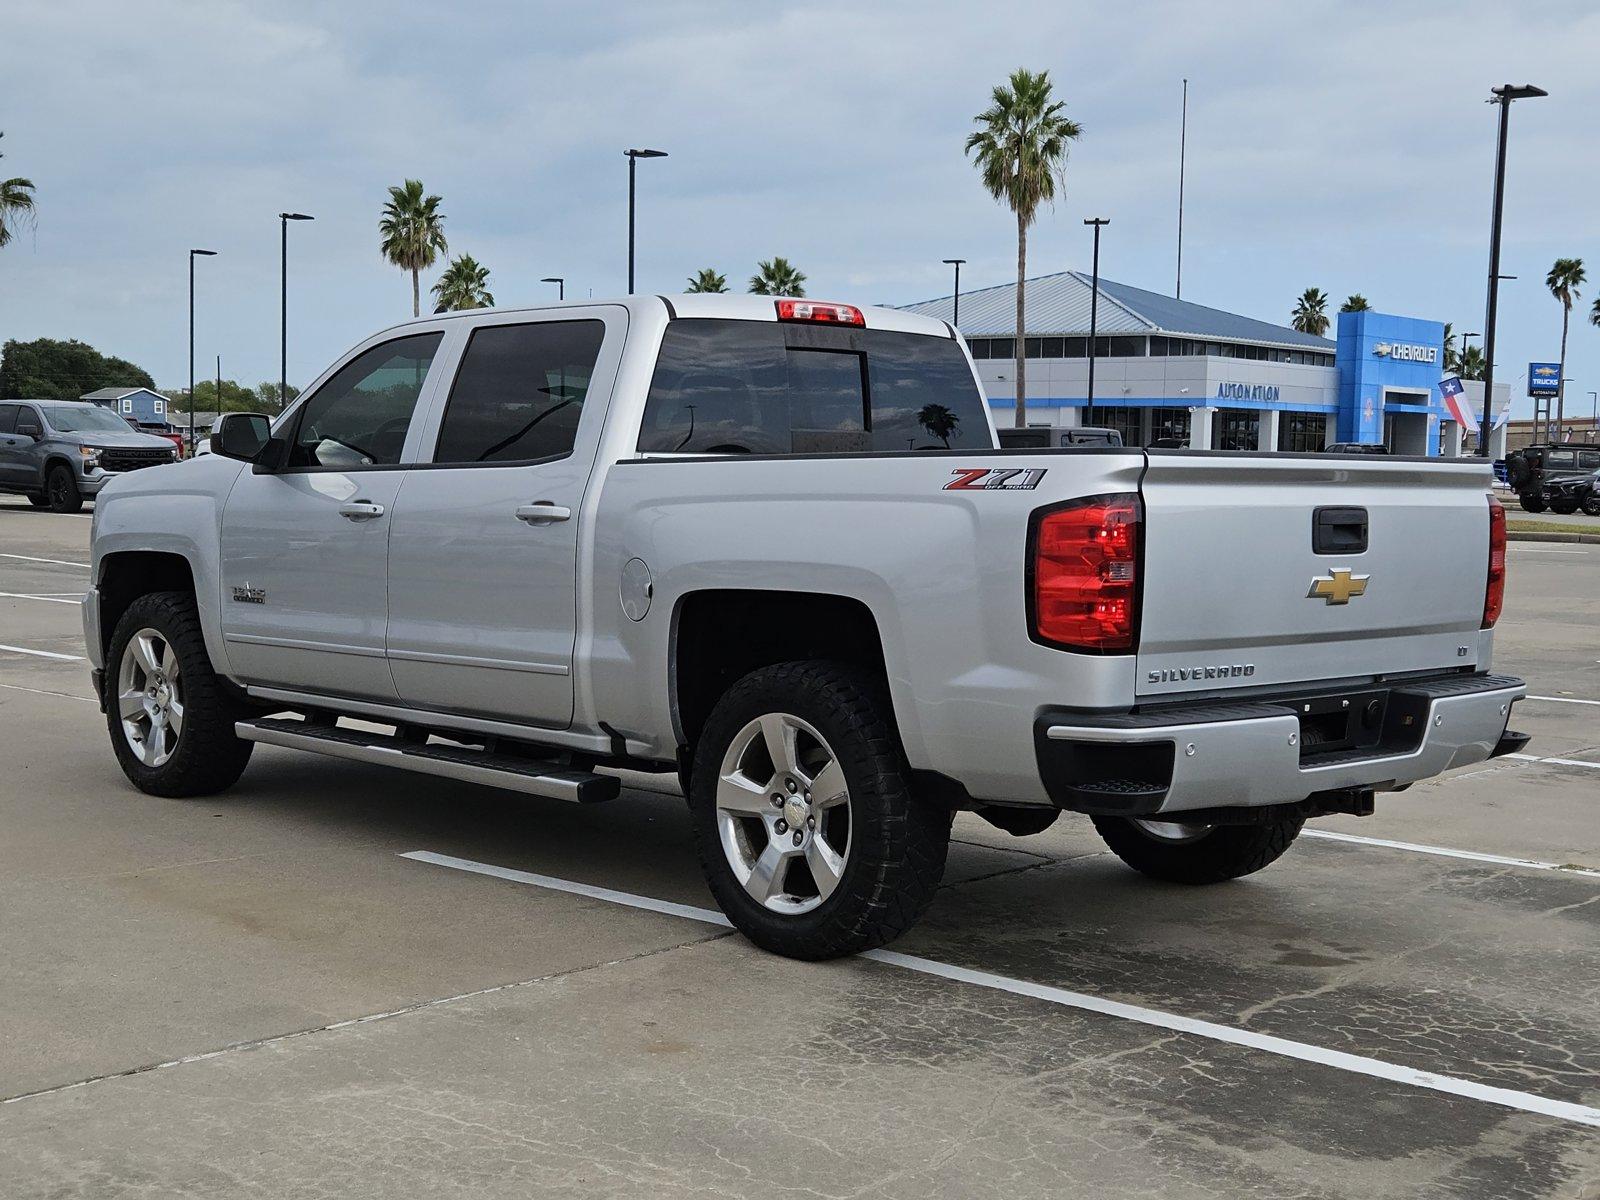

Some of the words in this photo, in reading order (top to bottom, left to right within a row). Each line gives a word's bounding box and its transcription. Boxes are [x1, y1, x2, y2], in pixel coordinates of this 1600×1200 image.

[1392, 343, 1438, 363] CHEVROLET
[1217, 382, 1280, 401] AUTONATION
[1532, 378, 1559, 386] TRUCKS
[942, 468, 1048, 491] Z71
[1147, 663, 1255, 684] SILVERADO
